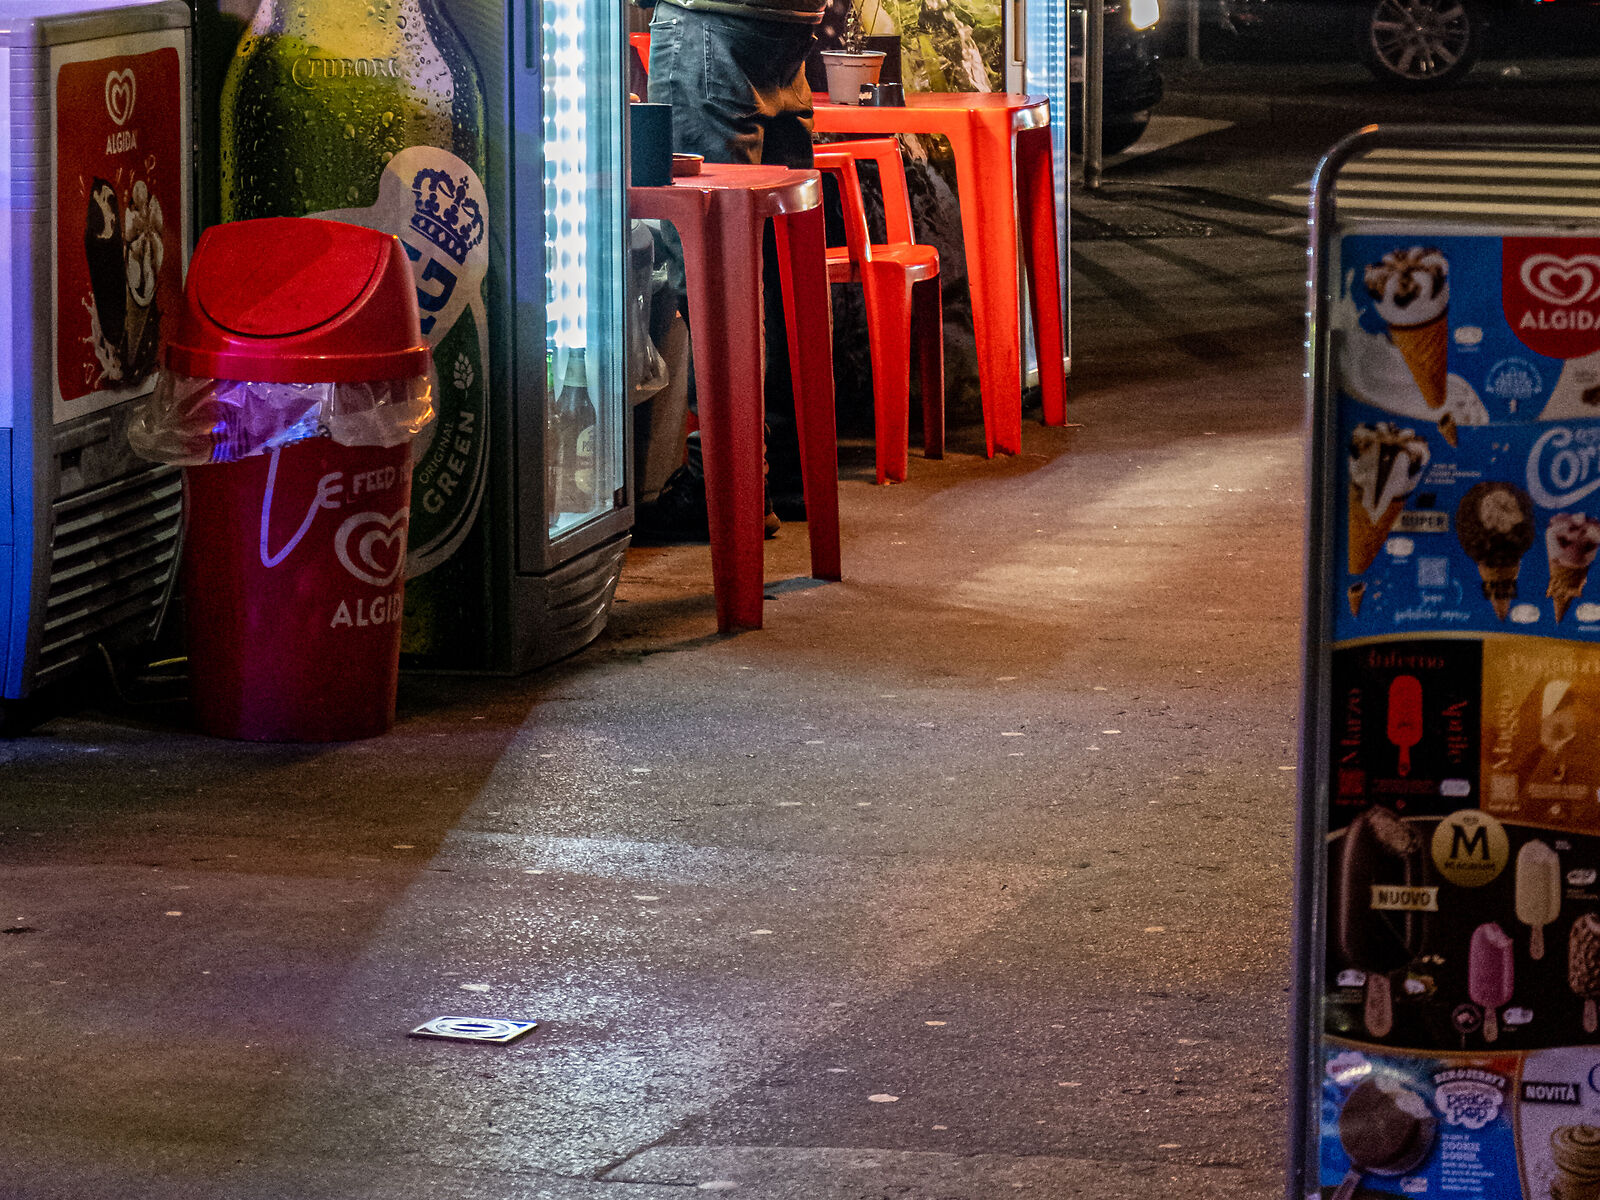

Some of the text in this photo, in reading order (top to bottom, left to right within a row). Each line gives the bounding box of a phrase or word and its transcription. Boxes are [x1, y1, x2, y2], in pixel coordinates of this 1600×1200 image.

[106, 130, 137, 155] ALGIDA
[418, 421, 455, 485] ORIGINAL
[422, 410, 476, 514] GREEN
[1525, 425, 1600, 510] Cor
[353, 466, 396, 494] FEED
[1449, 824, 1491, 862] M
[1378, 891, 1432, 906] NUOVO
